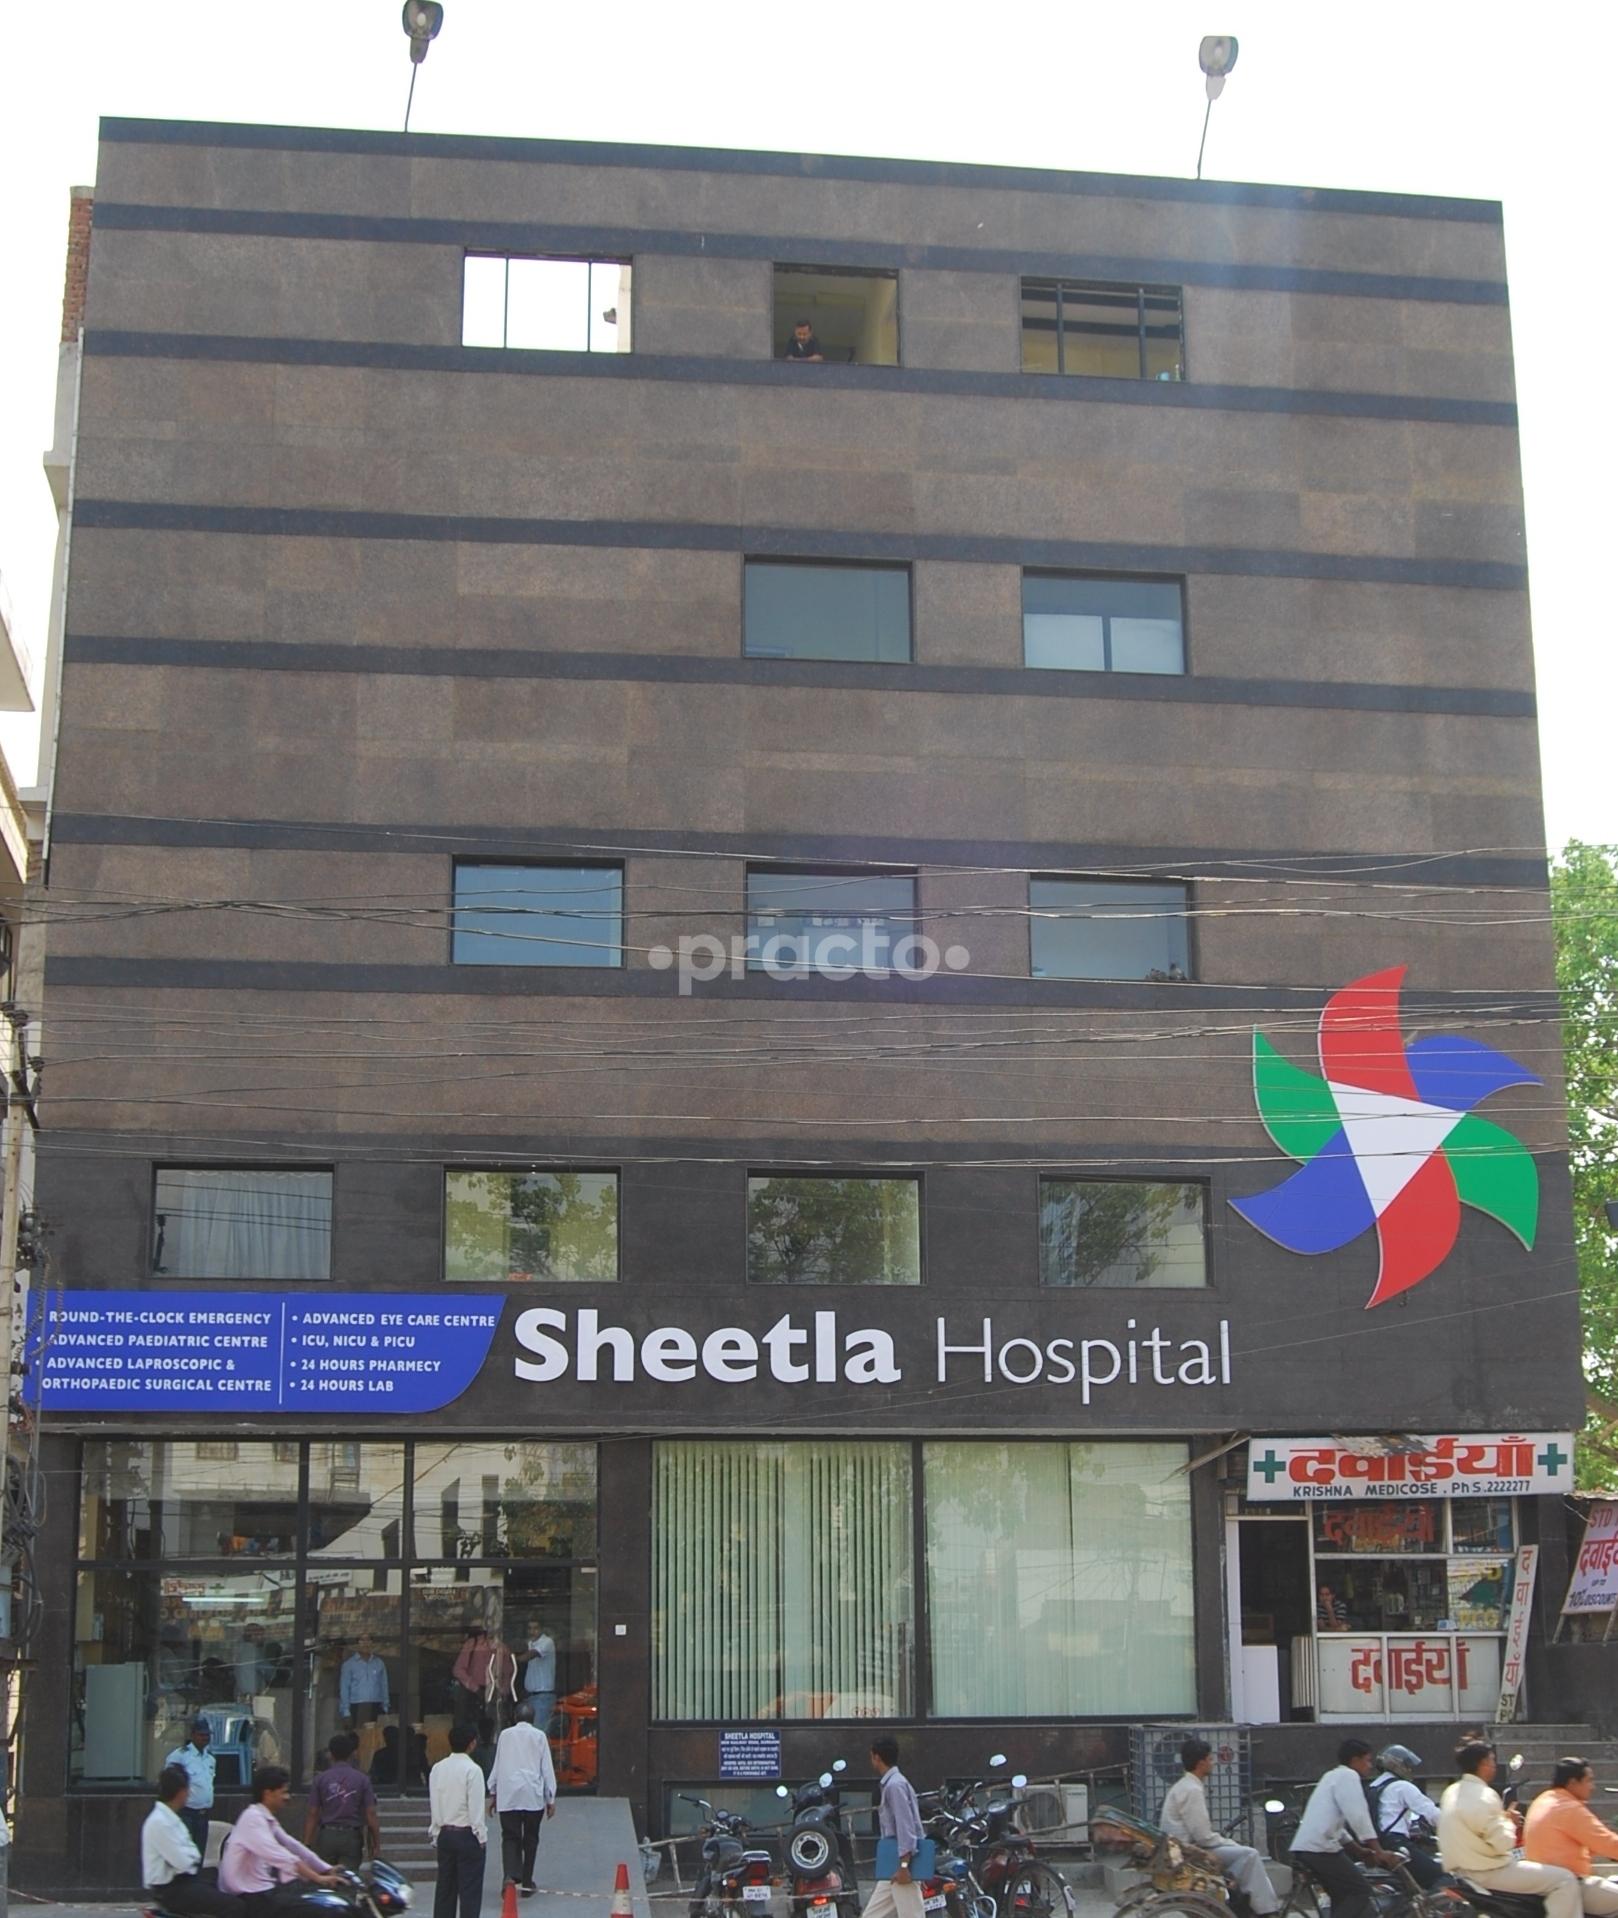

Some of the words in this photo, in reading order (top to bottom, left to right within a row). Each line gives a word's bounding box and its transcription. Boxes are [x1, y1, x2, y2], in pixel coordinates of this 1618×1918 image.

[49, 1311, 184, 1324] ROUND-THE-CLOCK
[189, 1312, 271, 1325] EMERGENCY
[302, 1313, 375, 1325] ADVANCED
[380, 1314, 403, 1326] EYE
[407, 1314, 440, 1326] CARE
[444, 1315, 495, 1327] CENTRE
[50, 1334, 124, 1346] ADVANCED
[128, 1334, 210, 1347] PAEDIATRIC
[214, 1335, 268, 1348] CENTRE
[302, 1335, 329, 1348] ICU,
[333, 1336, 366, 1347] NICU
[370, 1336, 380, 1347] &
[384, 1336, 415, 1348] PICU
[514, 1307, 902, 1383] Sheetla
[936, 1317, 1231, 1404] Hospital
[47, 1357, 123, 1370] ADVANCED
[127, 1358, 222, 1371] LAPROSCOPIC
[226, 1359, 236, 1371] &
[301, 1359, 315, 1371] 24
[319, 1359, 365, 1371] HOURS
[369, 1360, 441, 1372] PHARMECY
[42, 1377, 141, 1391] ORTHOPAEDIC
[145, 1378, 214, 1392] SURGICAL
[217, 1379, 272, 1392] CENTRE
[300, 1380, 315, 1391] 24
[319, 1380, 364, 1392] HOURS
[368, 1381, 394, 1392] LAB
[1293, 1485, 1353, 1497] KRISHNA
[1365, 1482, 1438, 1495] MEDICOSE
